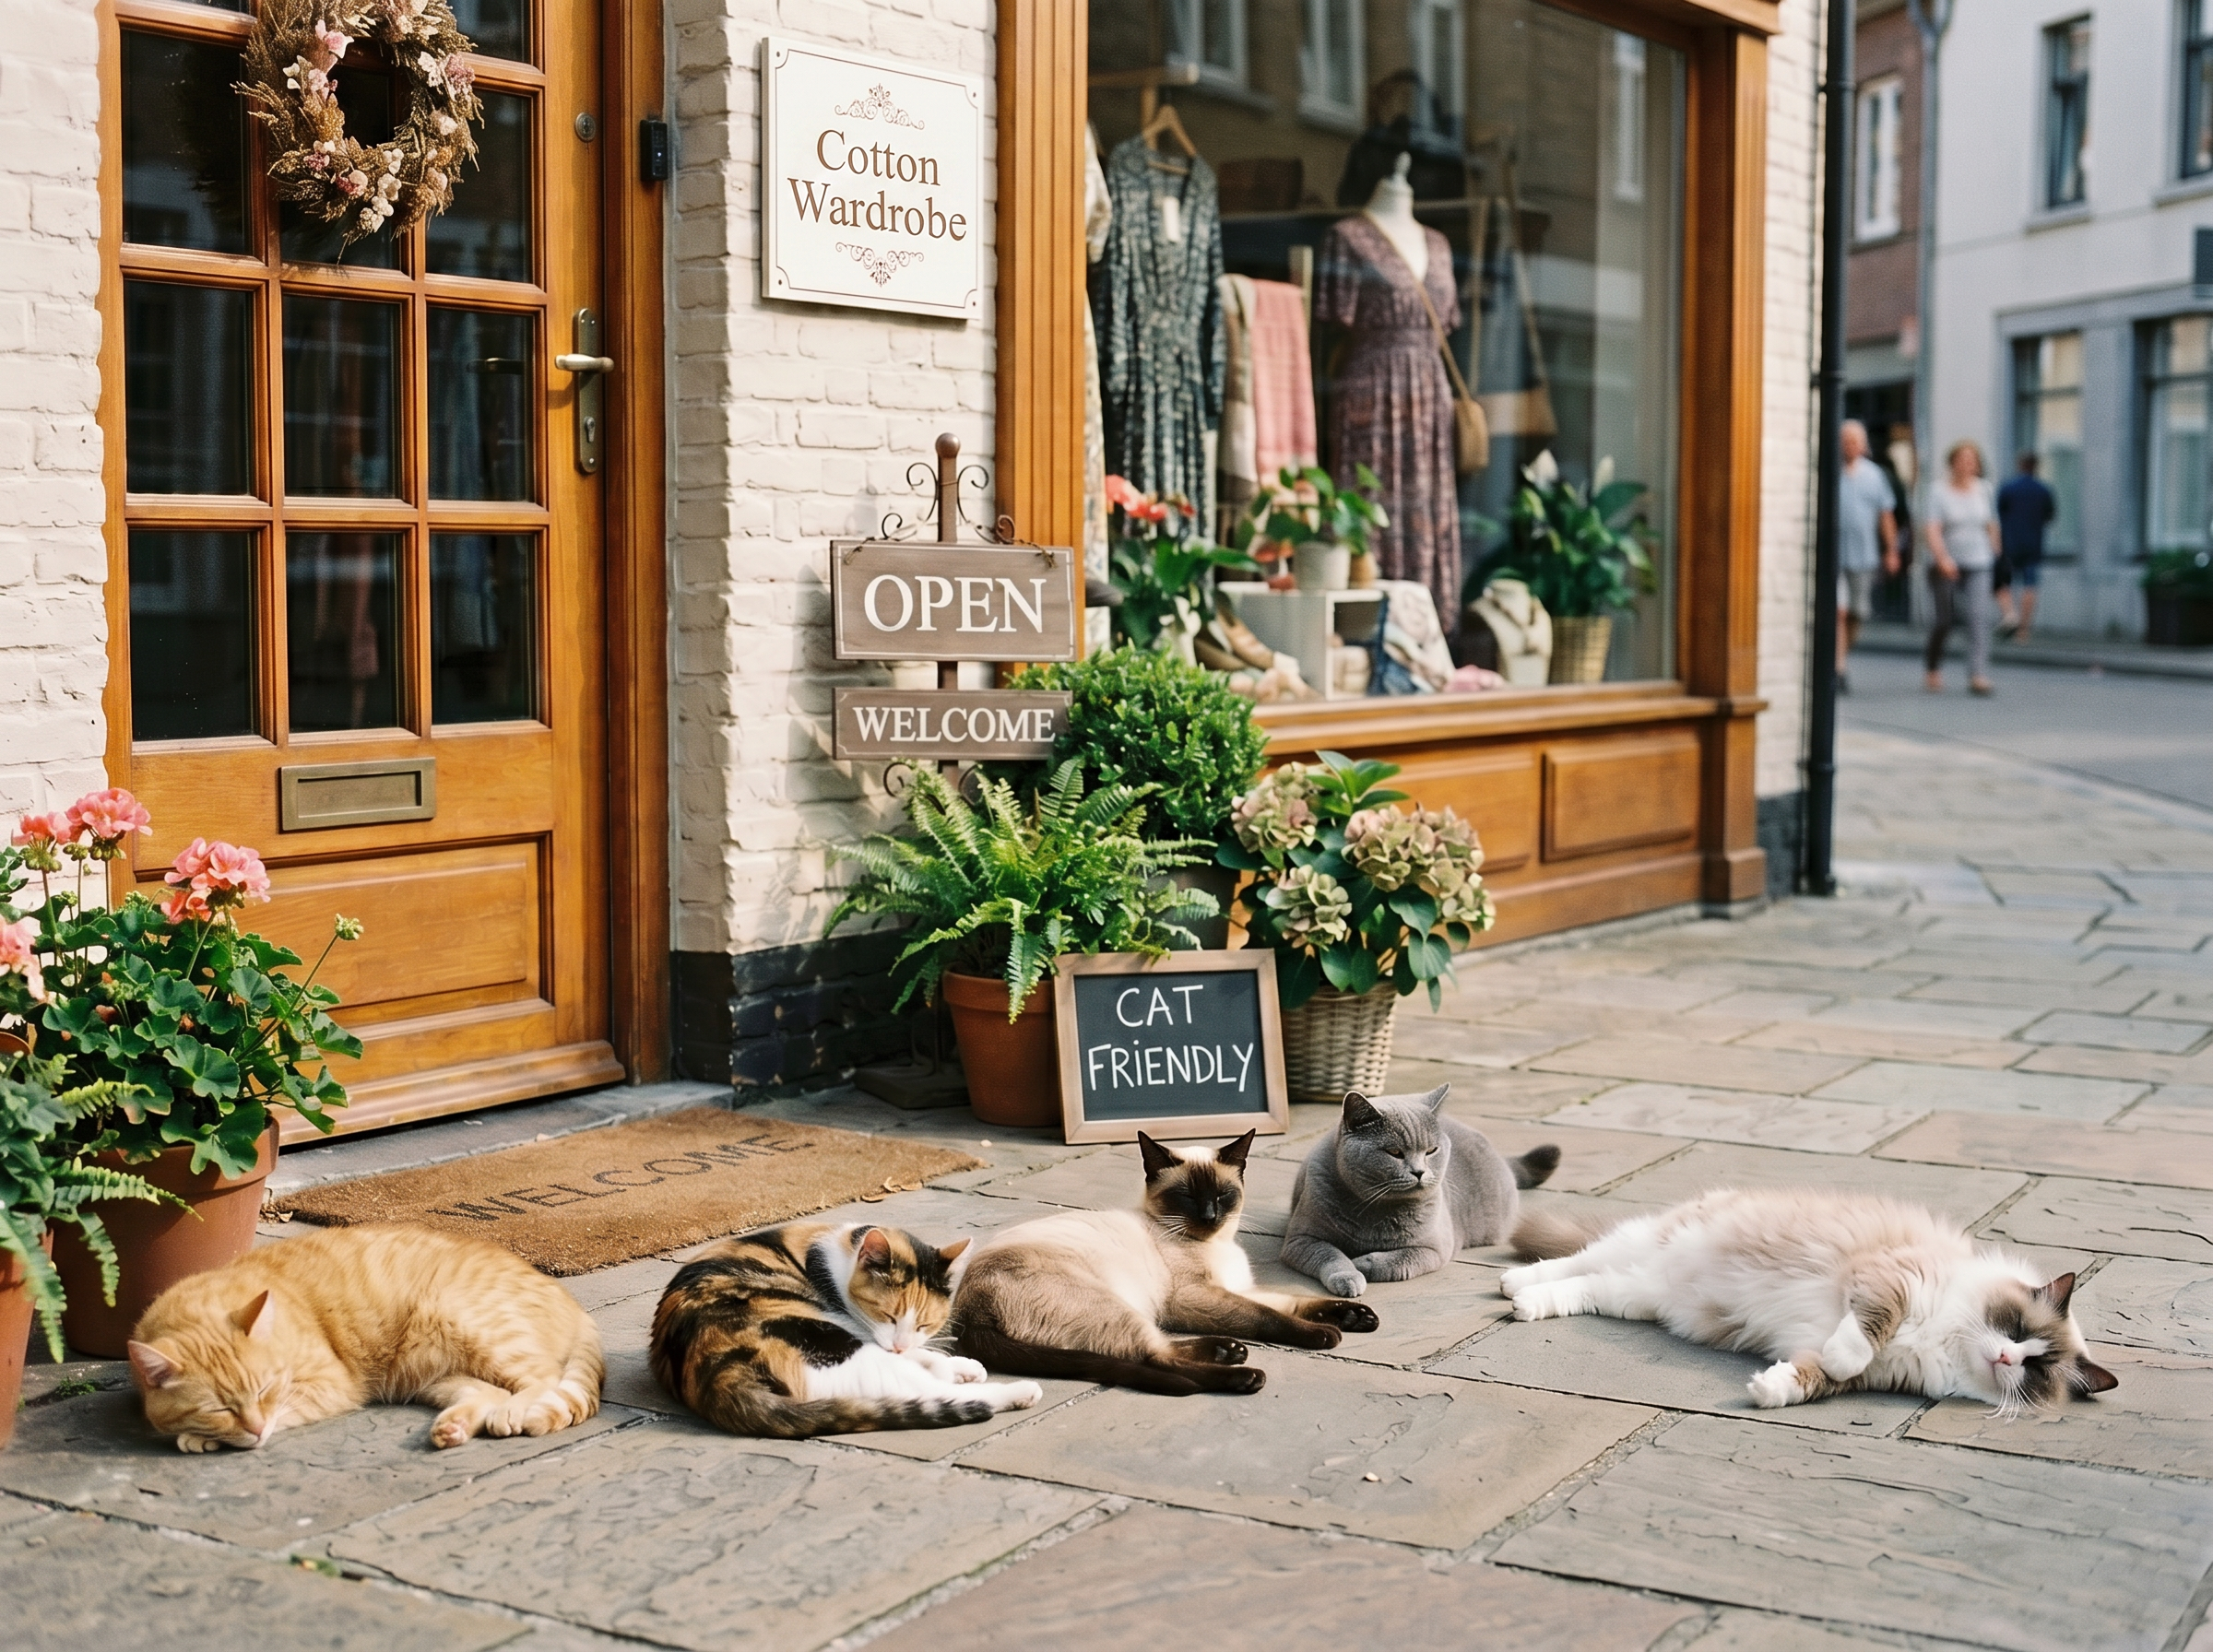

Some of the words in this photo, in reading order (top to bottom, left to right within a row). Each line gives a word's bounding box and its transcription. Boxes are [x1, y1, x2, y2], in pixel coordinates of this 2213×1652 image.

[817, 130, 941, 186] Cotton
[787, 177, 967, 242] Wardrobe
[864, 574, 1047, 633] OPEN
[852, 706, 1056, 742] WELCOME
[1116, 985, 1203, 1027] CAT
[426, 1133, 815, 1221] WELCOME
